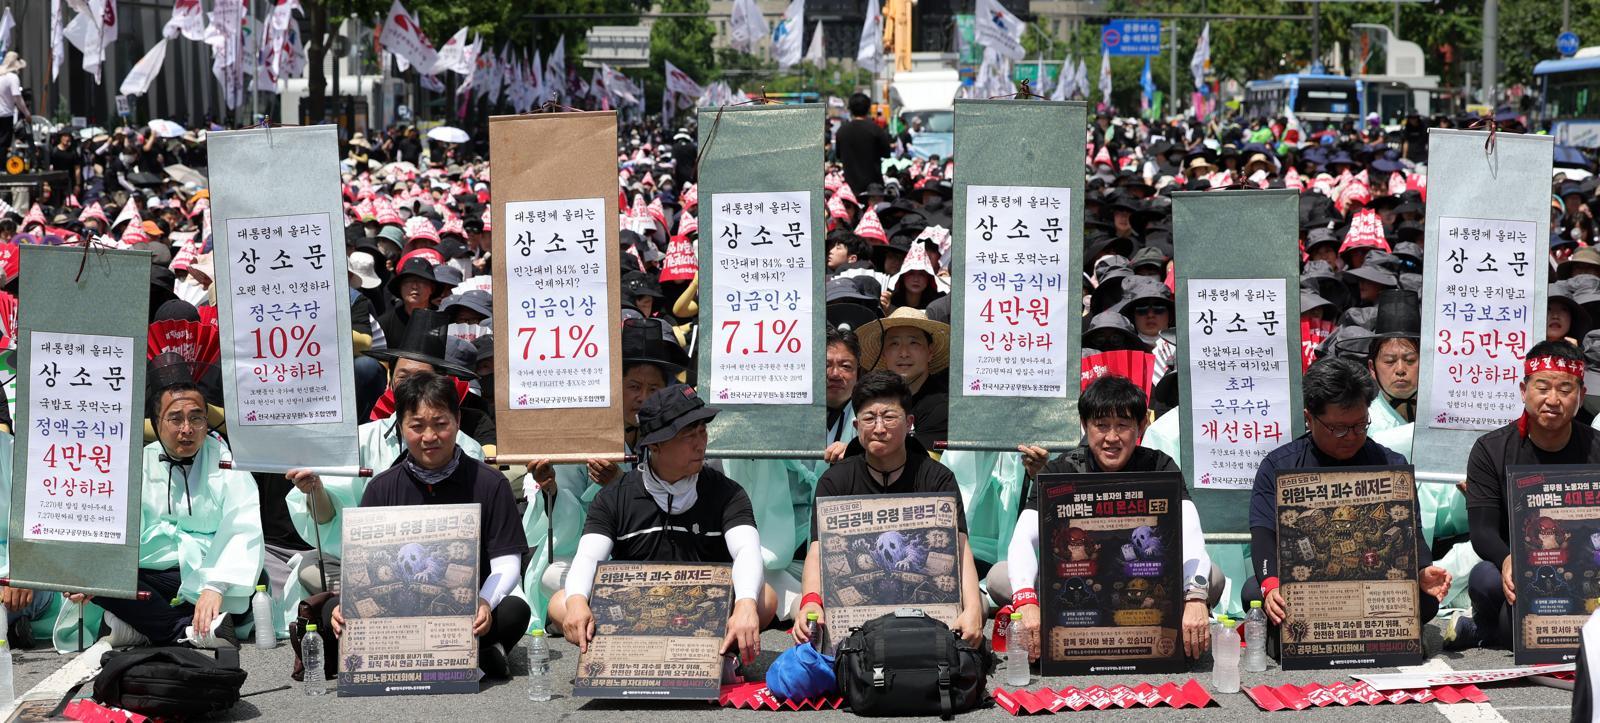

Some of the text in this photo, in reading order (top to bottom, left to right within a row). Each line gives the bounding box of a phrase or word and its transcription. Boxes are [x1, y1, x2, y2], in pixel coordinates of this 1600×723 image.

[721, 201, 802, 215] 대통령께 올리는
[977, 195, 1061, 209] 대통령께 올리는
[514, 208, 595, 223] 대통령께 올리는
[237, 224, 322, 240] 대통령께 올리는
[1449, 227, 1527, 243] 대통령께 올리는
[720, 257, 805, 270] 민간대비 84% 임금
[976, 252, 1060, 266] 국밥도 못먹는다
[514, 262, 600, 277] 민간대비 84% 임금
[740, 271, 786, 283] 언제까지?
[236, 280, 330, 295] 오랜 헌신, 인정하라
[535, 277, 580, 290] 언제까지?
[971, 272, 1061, 292] 정액급식비
[1197, 289, 1277, 302] 대통령께 올리는
[1446, 284, 1526, 299] 책임만 묻지말고
[521, 295, 596, 318] 임금인상
[726, 290, 801, 312] 임금인상
[249, 300, 320, 322] 정근수당
[980, 296, 1048, 326] 4만원
[1442, 301, 1527, 324] 직급보조비
[250, 324, 321, 359] 10%
[517, 324, 598, 360] 7.1%
[721, 319, 802, 355] 7.1%
[980, 331, 1053, 352] 인상하라
[1437, 329, 1526, 360] 3.5만원
[41, 342, 124, 358] 대통령께 올리는
[1202, 346, 1274, 357] 반값짜리 야근비
[254, 361, 324, 382] 인상하라
[1198, 360, 1280, 372] 악덕업주 여기있네
[1448, 363, 1518, 385] 인상하라
[982, 383, 1061, 392] 전국시군구공무원노동조합연맹
[1225, 376, 1255, 392] 초과
[529, 395, 605, 404] 전국시군구공무원노동조합연맹
[730, 391, 808, 399] 전국시군구공무원노동조합연맹
[39, 398, 122, 413] 국밥도 못먹는다
[1210, 399, 1271, 416] 근무수당
[36, 417, 124, 440] 정액급식비
[1201, 420, 1283, 444] 개선하라
[43, 443, 112, 473] 4만원
[43, 476, 114, 498] 인상하라
[1281, 485, 1329, 504] 위험누적
[1330, 482, 1353, 499] 괴수
[1354, 477, 1393, 497] 해저드
[1543, 482, 1590, 492] 공무원 노동자의
[1073, 490, 1144, 502] 공무원 노동자의 권리를
[1526, 491, 1583, 508] 갉아먹는 4대
[1056, 500, 1167, 518] 갉아먹는 4대 몬스터 도감
[826, 511, 873, 530] 연금공백
[876, 508, 899, 524] 유령
[902, 504, 936, 521] 블랭크
[43, 527, 121, 539] 전국시군구공무원노동조합연맹
[350, 522, 396, 541] 연금공백
[400, 520, 422, 535] 유령
[425, 516, 458, 532] 블랭크
[600, 571, 647, 583] 위험누적
[650, 571, 672, 581] 괴수
[674, 569, 711, 580] 해저드
[1313, 621, 1341, 630] 위험누적
[1342, 621, 1363, 629] 괴수를
[1364, 620, 1384, 628] 멈추기
[1313, 630, 1335, 639] 안전한
[1336, 630, 1357, 639] 일터를
[1359, 629, 1374, 638] 함께
[1063, 638, 1077, 647] 함께
[1079, 637, 1100, 646] 맞서야
[1117, 637, 1124, 645] 수
[1297, 643, 1365, 655] 공무원노동자대회에서
[368, 660, 382, 668] 퇴직
[415, 659, 435, 667] 지급을
[353, 672, 422, 683] 공무원노동자대회에서
[591, 679, 661, 687] 공무원노동자대회에서
